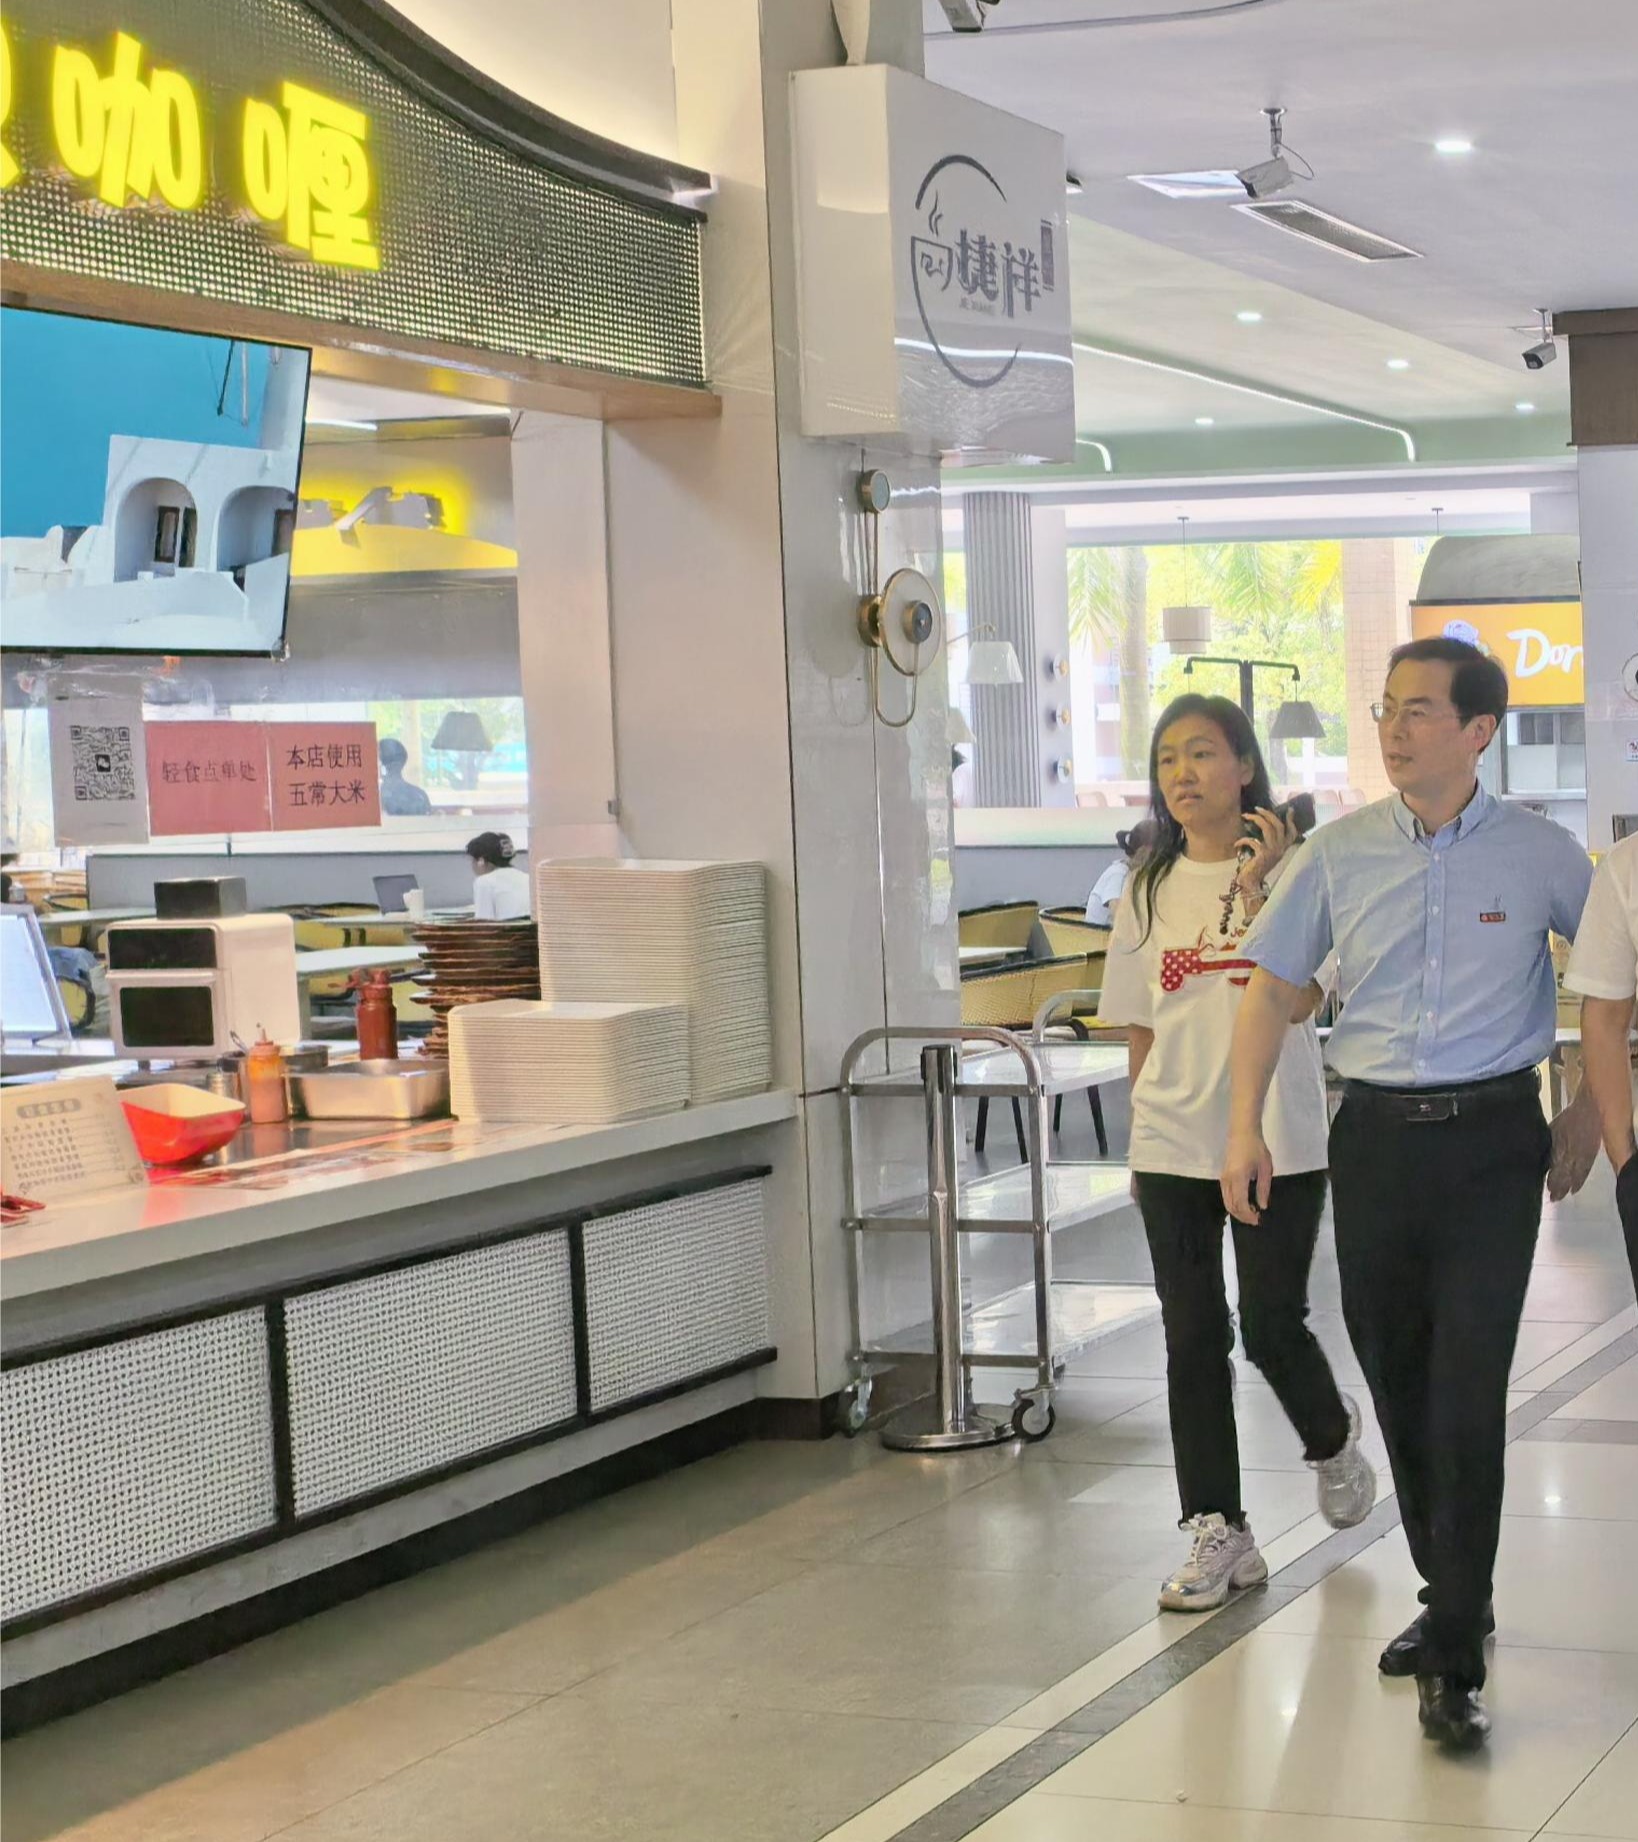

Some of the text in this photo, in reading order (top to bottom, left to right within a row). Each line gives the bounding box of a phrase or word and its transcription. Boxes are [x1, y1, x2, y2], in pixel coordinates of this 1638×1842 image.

[0, 18, 380, 270] 咖喱
[954, 229, 1041, 318] 捷祥
[286, 744, 362, 770] 本店使用
[162, 760, 257, 783] 轻食点单处
[289, 779, 366, 807] 五常大米
